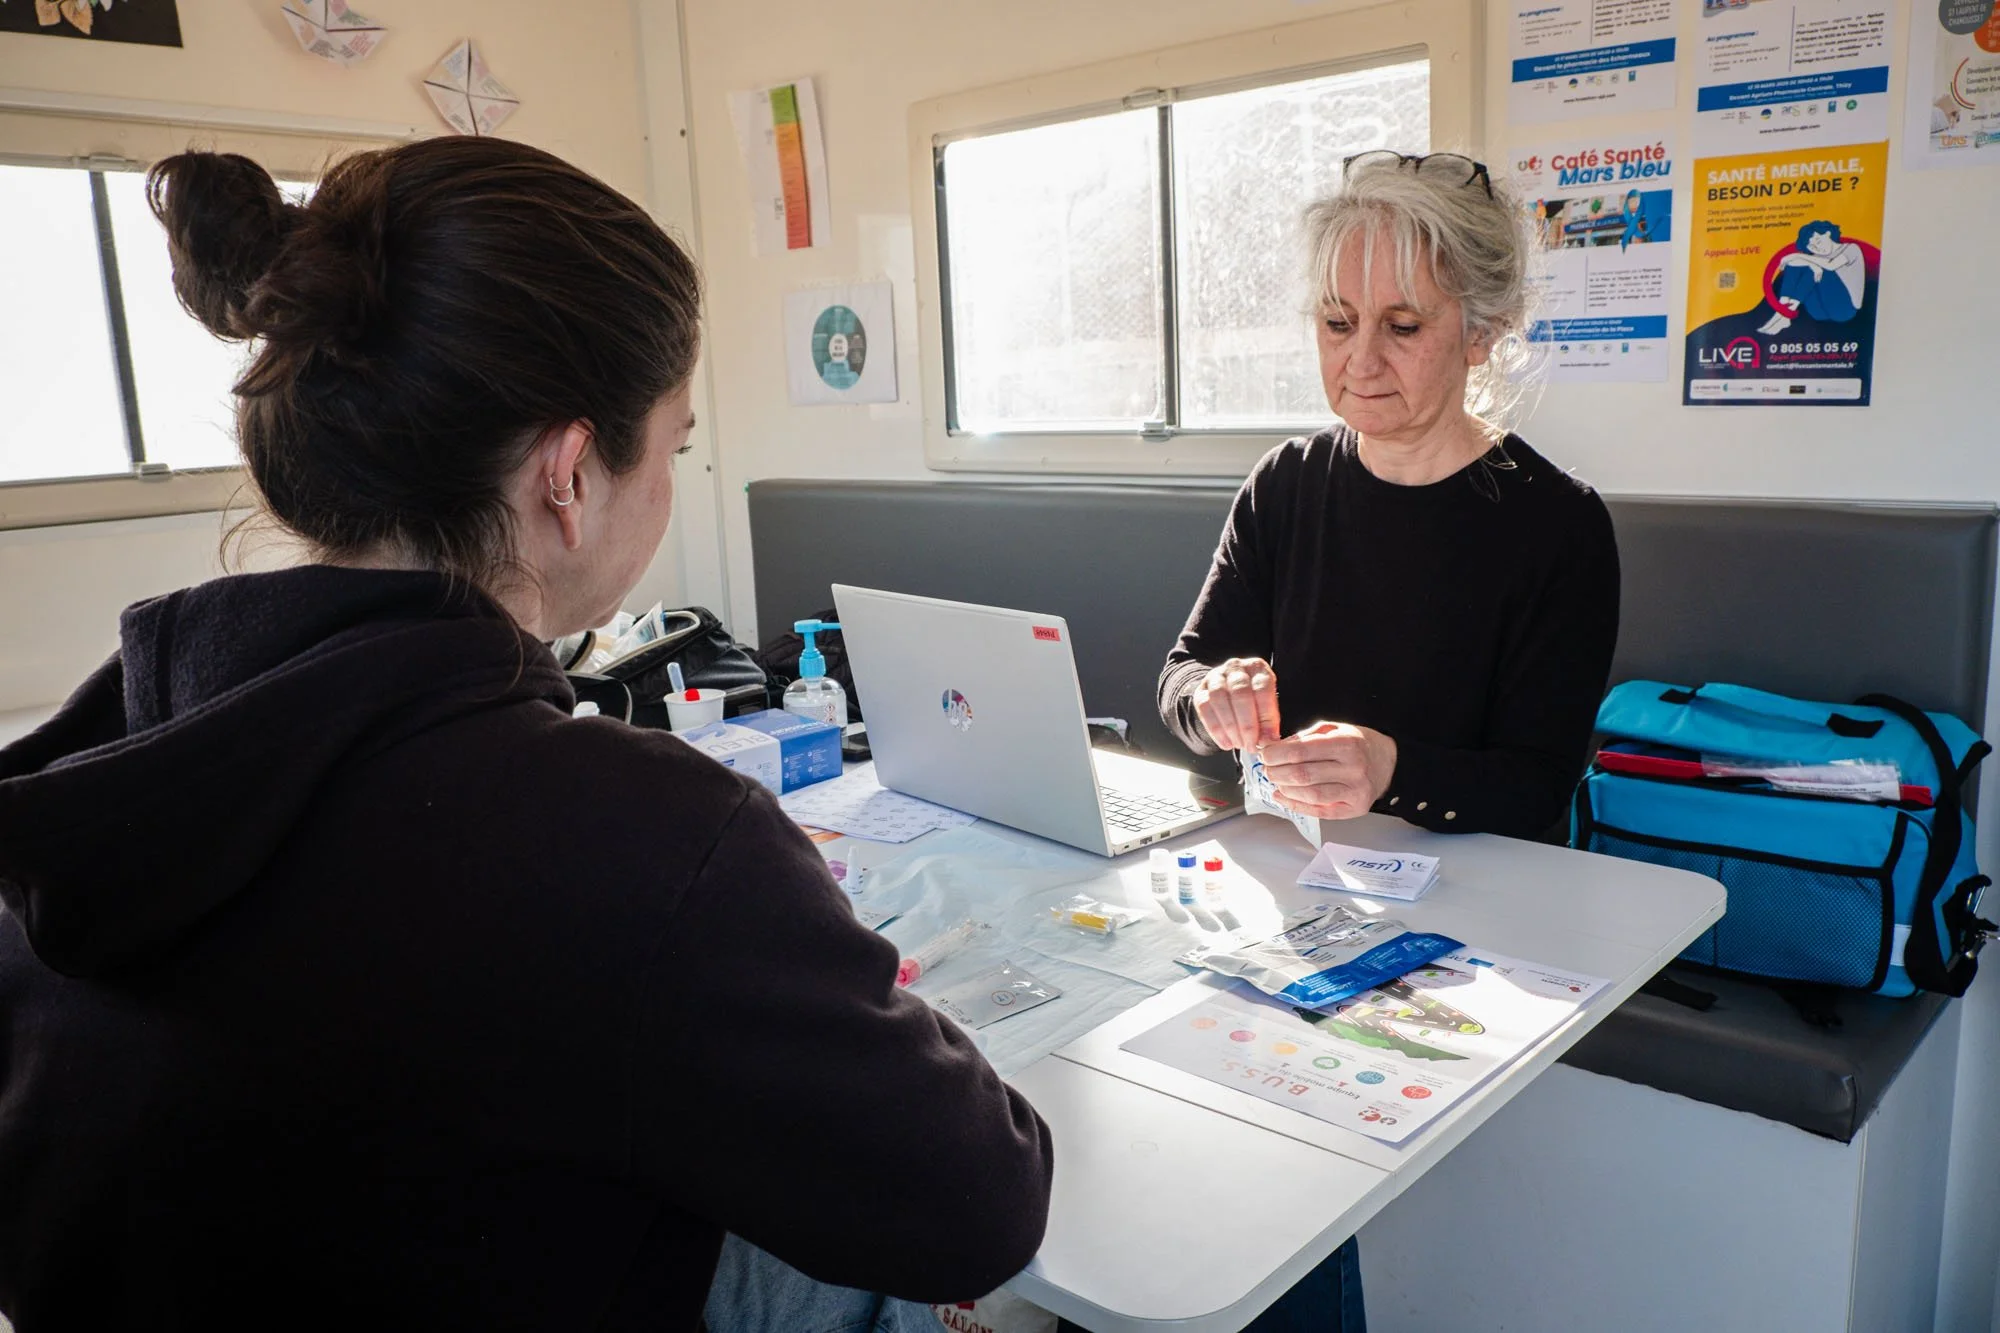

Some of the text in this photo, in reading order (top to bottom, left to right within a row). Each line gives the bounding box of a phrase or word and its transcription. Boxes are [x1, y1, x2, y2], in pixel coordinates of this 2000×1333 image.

[1552, 141, 1665, 170] Café Santé
[1558, 166, 1614, 186] Mars
[1619, 159, 1672, 179] bleu
[1708, 157, 1864, 185] SANTÉ MENTALE,
[1708, 177, 1859, 201] BESOIN D'AIDE ?
[1704, 246, 1760, 258] Appelez LIVE
[1698, 347, 1753, 363] LIVE
[1769, 342, 1859, 354] 0 805 05 05 69
[707, 734, 771, 753] BLEU
